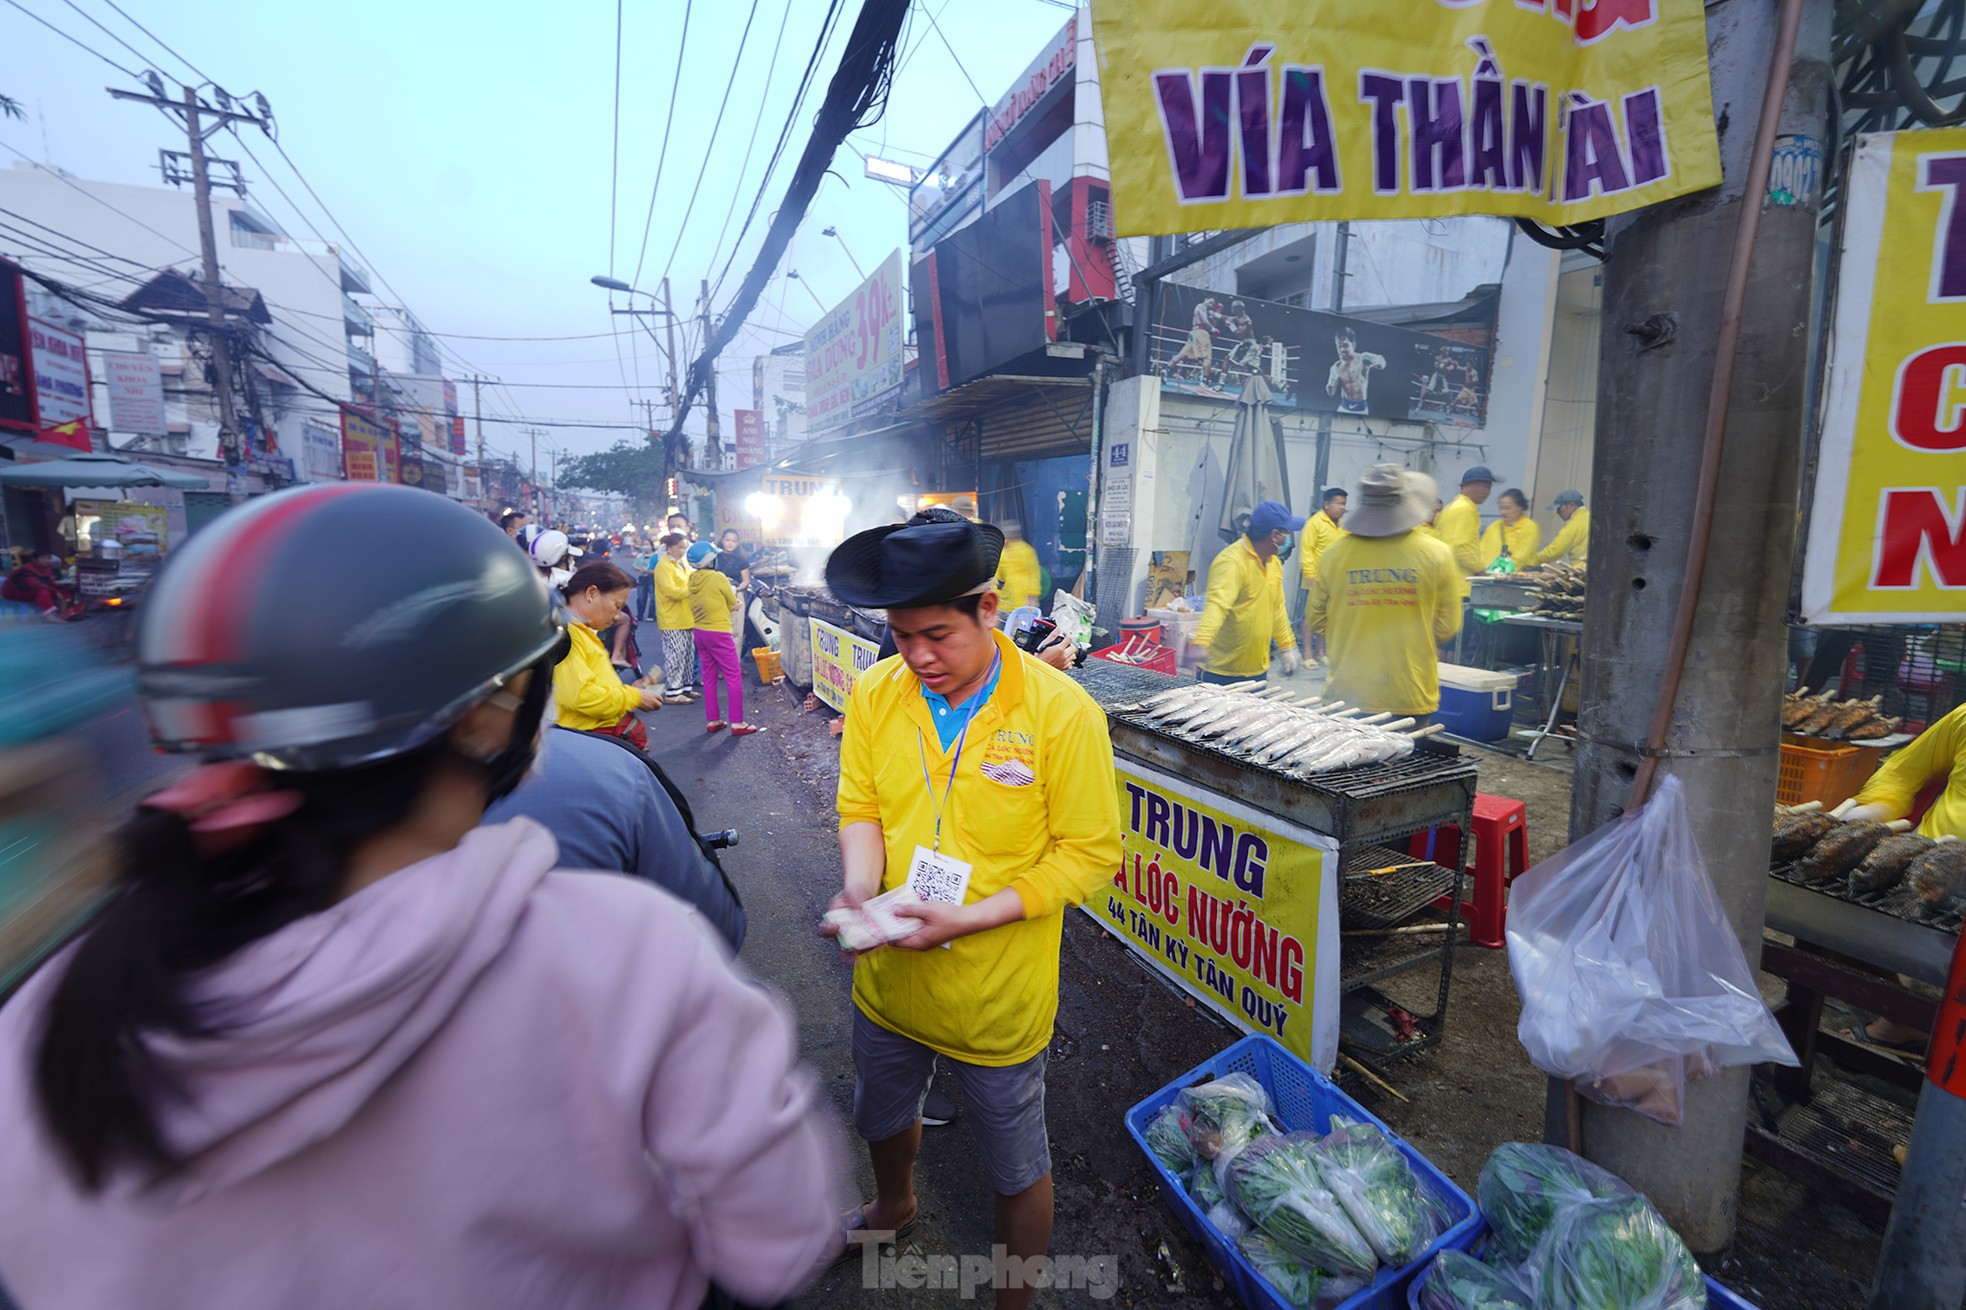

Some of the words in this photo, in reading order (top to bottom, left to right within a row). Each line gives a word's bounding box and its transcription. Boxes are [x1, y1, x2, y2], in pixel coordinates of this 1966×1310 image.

[1153, 42, 1342, 205] VÍA
[1359, 36, 1548, 197] THẦN
[1557, 86, 1669, 205] ÀI
[1112, 445, 1127, 458] 44
[1346, 568, 1419, 585] TRUNG
[817, 628, 839, 658] TRUNG
[1126, 781, 1269, 899] TRUNG
[1108, 895, 1126, 927] 44
[1129, 909, 1161, 953] TÂN
[1165, 938, 1189, 970] KỲ
[1193, 953, 1235, 1004] TÂN
[1242, 984, 1289, 1039] QUÝ
[1113, 834, 1129, 895] Á
[1134, 852, 1180, 927] LÓC
[1188, 884, 1305, 1007] NƯỚNG
